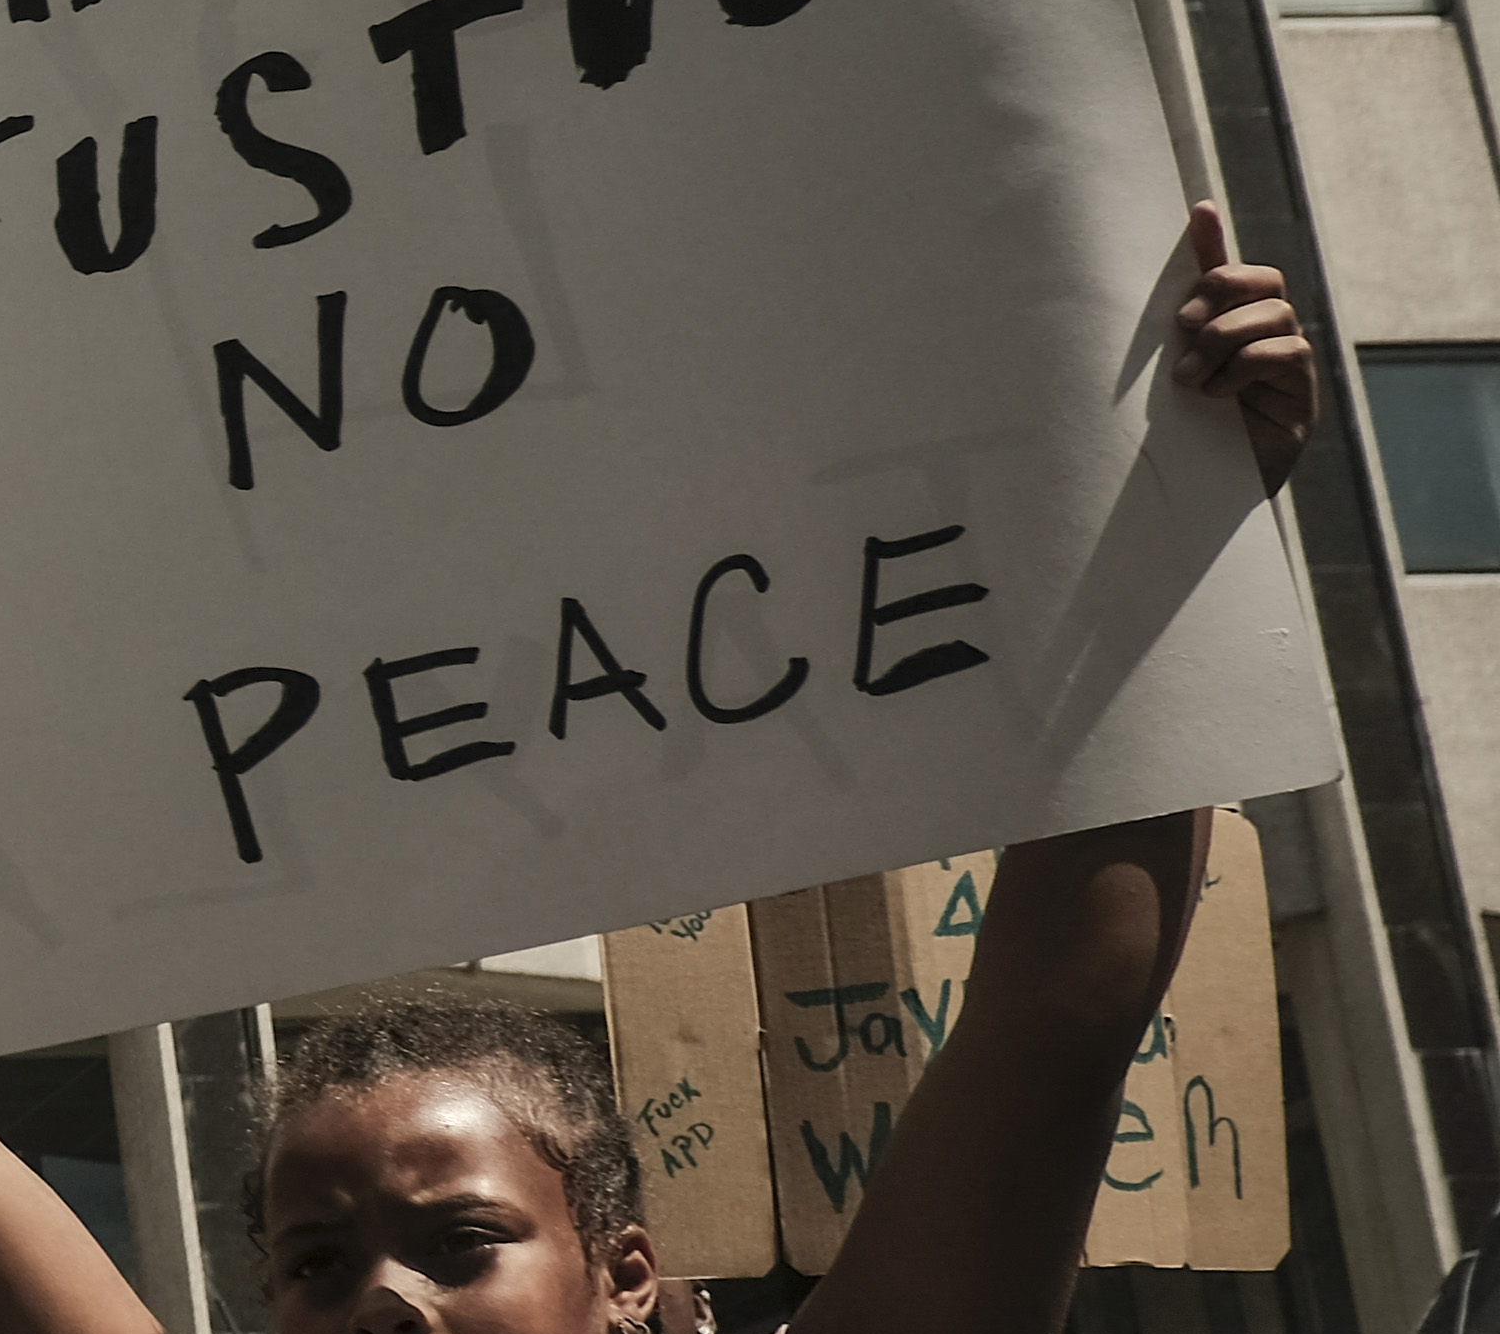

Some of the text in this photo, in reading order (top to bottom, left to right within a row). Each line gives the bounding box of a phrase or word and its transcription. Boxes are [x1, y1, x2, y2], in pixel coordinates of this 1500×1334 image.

[213, 285, 535, 491] NO
[182, 524, 991, 864] PEACE
[637, 1077, 702, 1137] FUCK
[660, 1122, 714, 1179] APD
